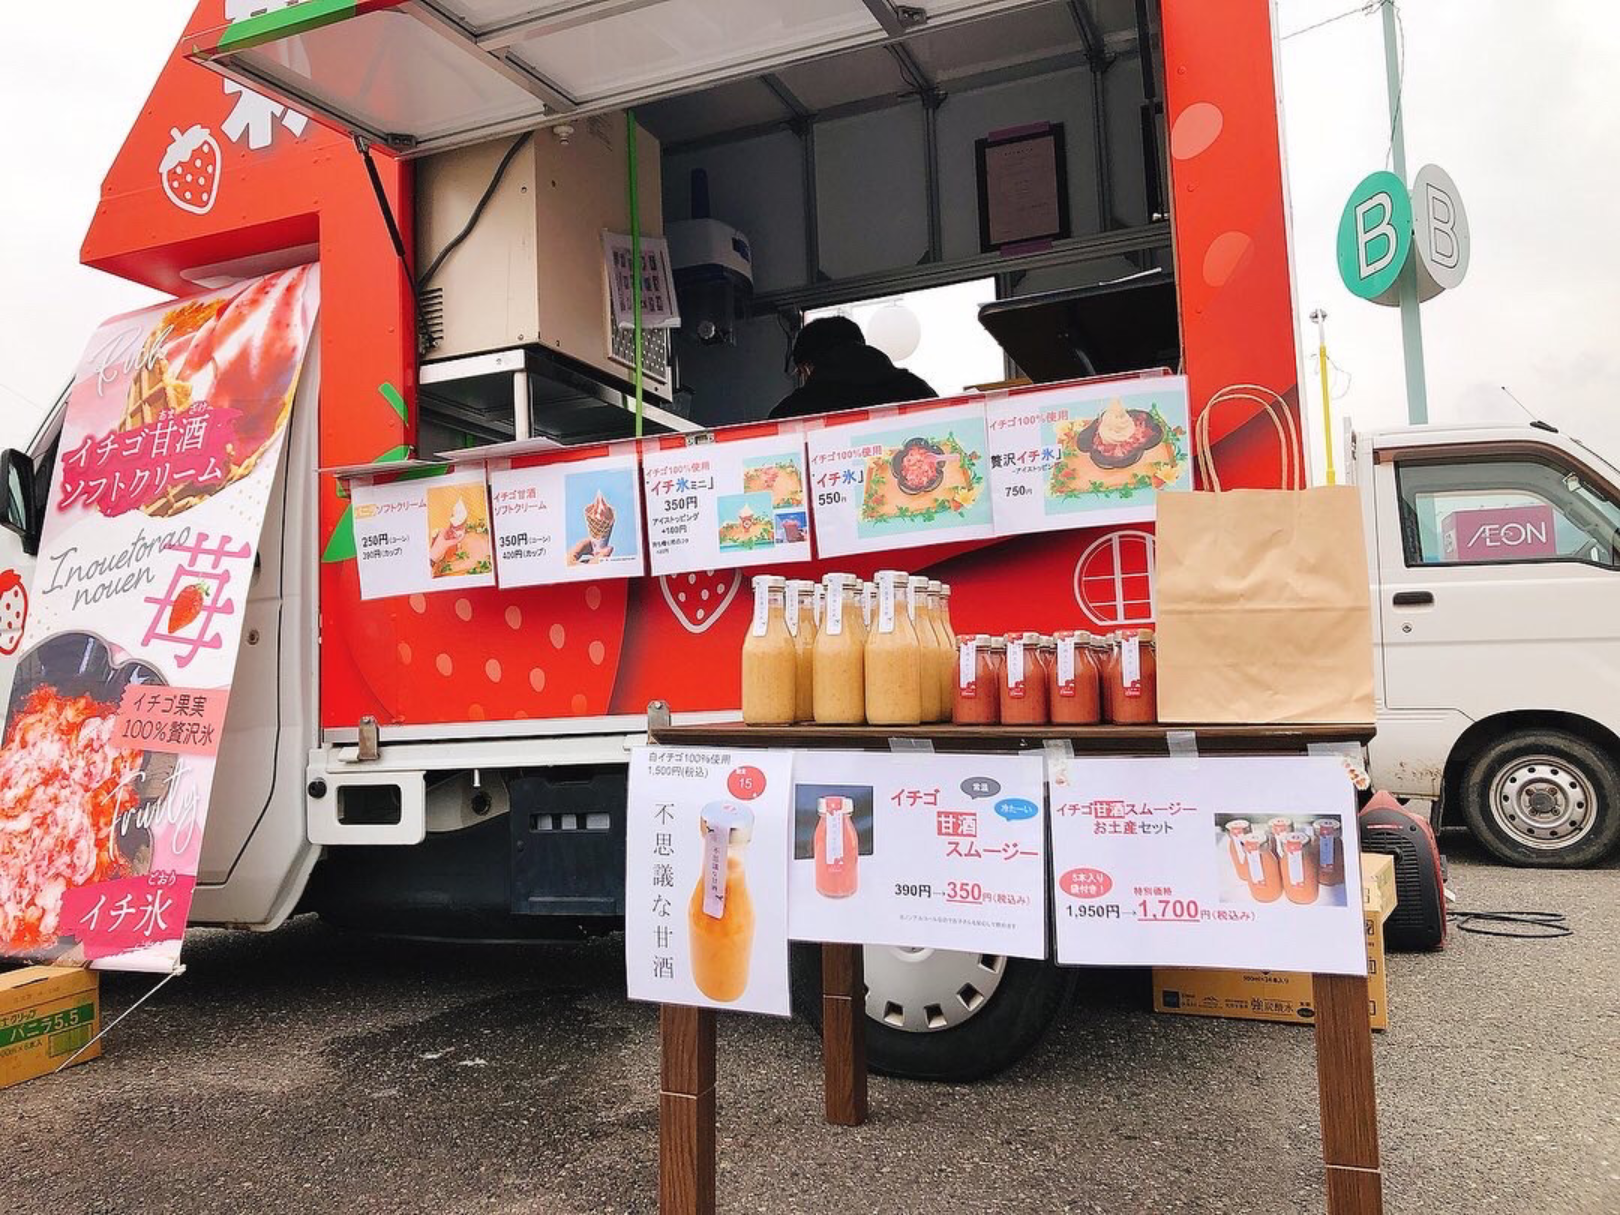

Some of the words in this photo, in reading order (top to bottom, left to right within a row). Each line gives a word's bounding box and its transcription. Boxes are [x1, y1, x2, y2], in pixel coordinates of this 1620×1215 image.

[1426, 182, 1461, 270] B
[1355, 192, 1399, 281] B
[67, 413, 210, 468] イチゴ甘酒
[60, 457, 223, 507] ソフトクリーム
[493, 488, 537, 503] イチゴ甘酒
[664, 495, 698, 511] 350円
[375, 499, 428, 515] ソフトクリーム
[494, 502, 547, 516] ソフトクリーム
[71, 565, 156, 611] nouen
[132, 693, 208, 718] イチゴ果実
[739, 777, 753, 790] 15
[890, 788, 940, 807] イチゴ
[1056, 800, 1198, 819] イチゴ甘酒スムージー
[937, 811, 977, 838] 甘酒
[1093, 820, 1173, 836] お土産セット
[946, 840, 1039, 861] スムージー
[651, 803, 675, 979] 不思議な甘酒
[894, 884, 932, 899] 390円
[79, 888, 173, 937] イチ氷
[1065, 903, 1121, 919] 1,950円
